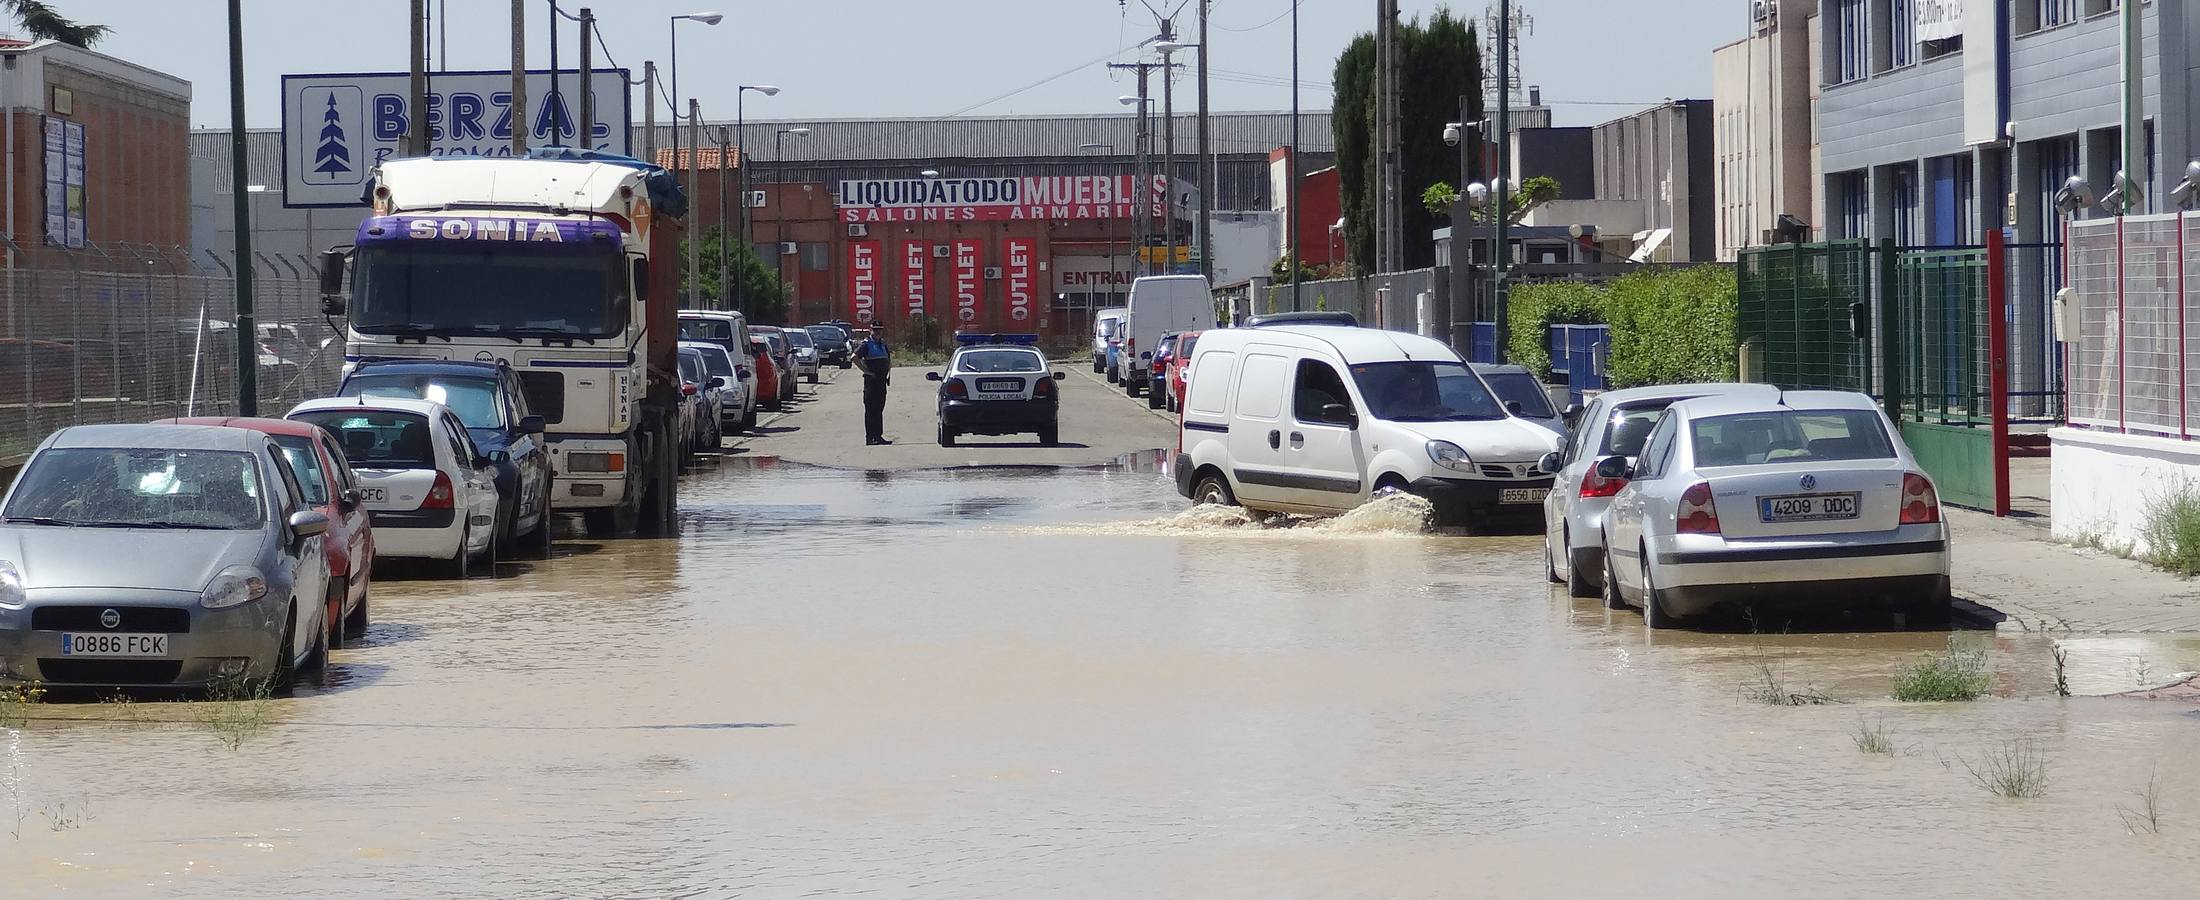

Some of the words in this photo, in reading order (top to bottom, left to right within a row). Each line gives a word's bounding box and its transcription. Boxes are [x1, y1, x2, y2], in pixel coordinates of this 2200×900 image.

[373, 92, 610, 141] BERZAL
[409, 219, 563, 242] SONIA
[846, 208, 976, 222] SALONES
[855, 244, 873, 324] OUTLET
[958, 242, 975, 321] OUTLET
[1010, 241, 1028, 321] OUTLET
[620, 376, 628, 423] HENAR
[360, 489, 383, 500] CFC
[1774, 500, 1811, 514] 4209
[1824, 498, 1852, 513] DDC
[75, 636, 120, 652] 0886
[128, 636, 163, 653] FCK
